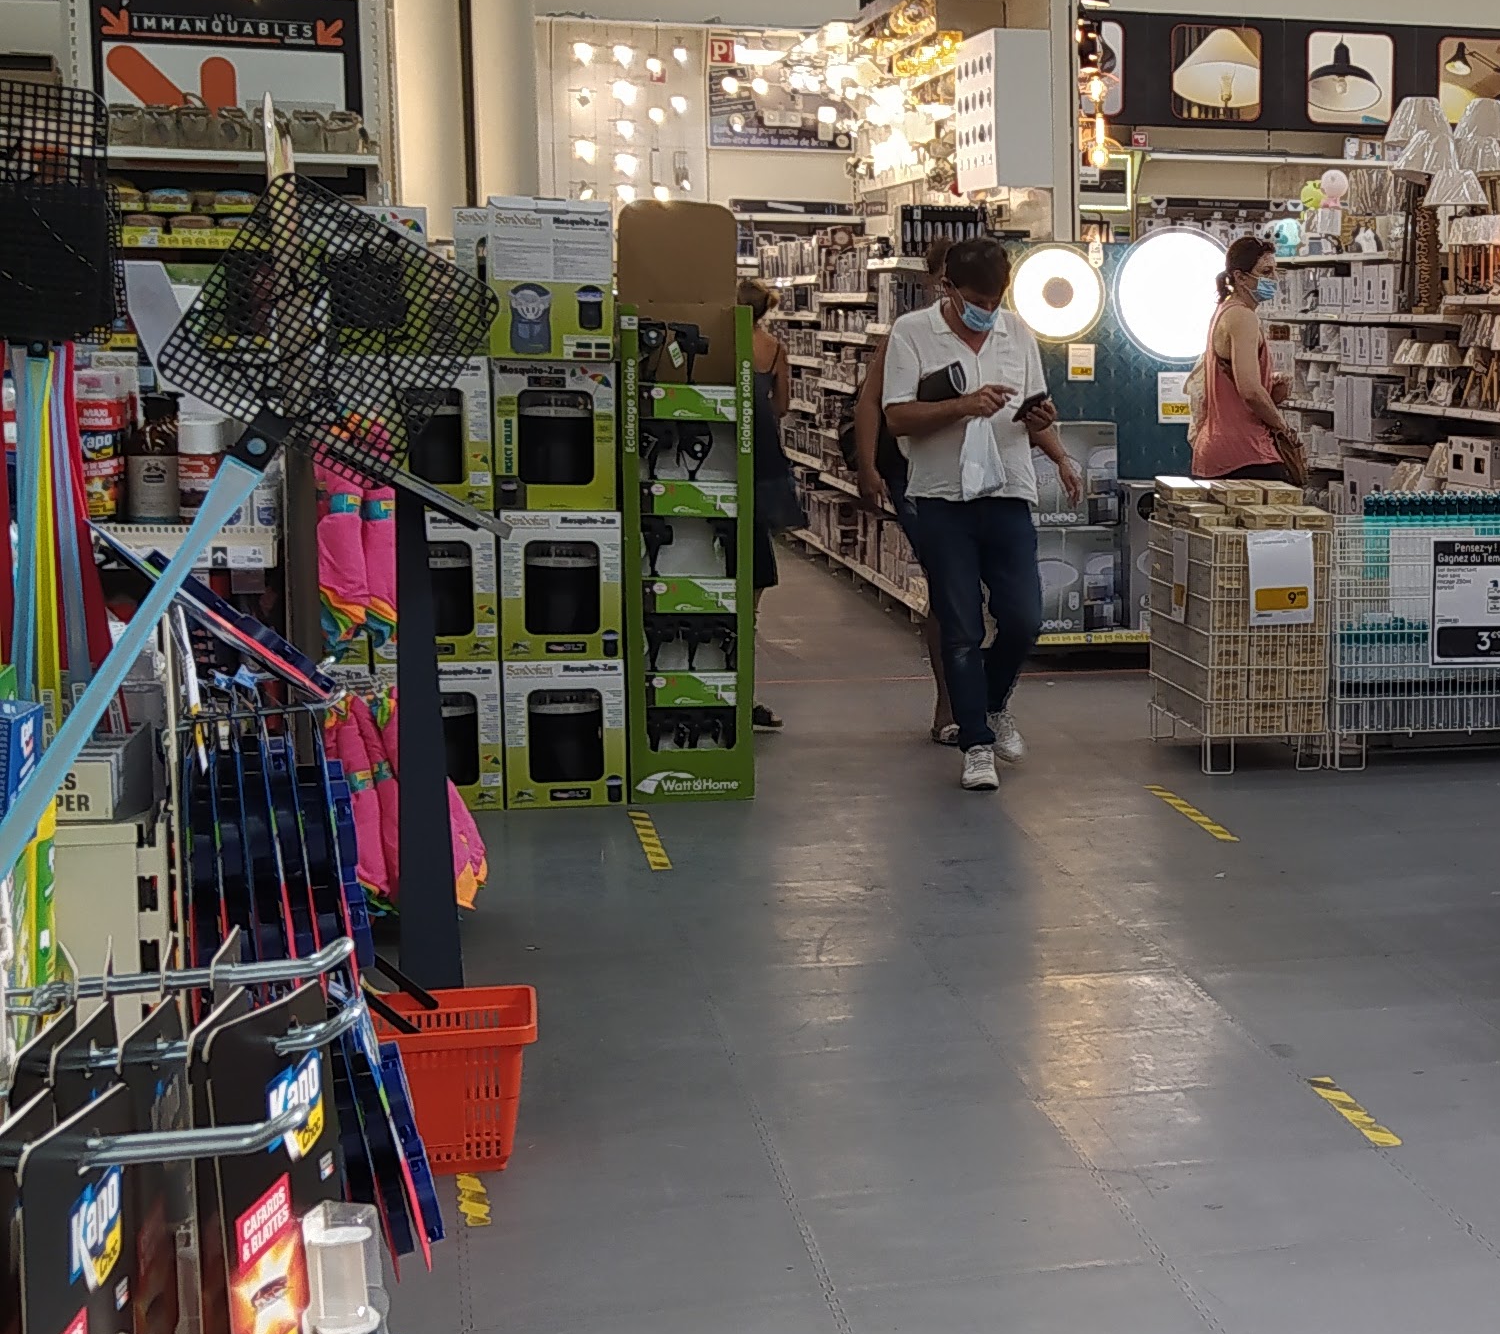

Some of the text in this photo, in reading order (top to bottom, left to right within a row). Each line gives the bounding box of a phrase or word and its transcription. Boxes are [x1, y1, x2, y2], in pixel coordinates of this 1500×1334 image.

[132, 15, 314, 38] IMMANQUABLES
[739, 360, 754, 454] Eclairage solaire
[1437, 553, 1468, 564] Gagnez
[1470, 553, 1480, 563] du
[1454, 543, 1493, 553] Pensez-y
[661, 777, 739, 792] Watt&Home
[243, 1185, 286, 1239] CAFARDS
[252, 1203, 290, 1255] BLATTES
[71, 1171, 120, 1291] Kapo
